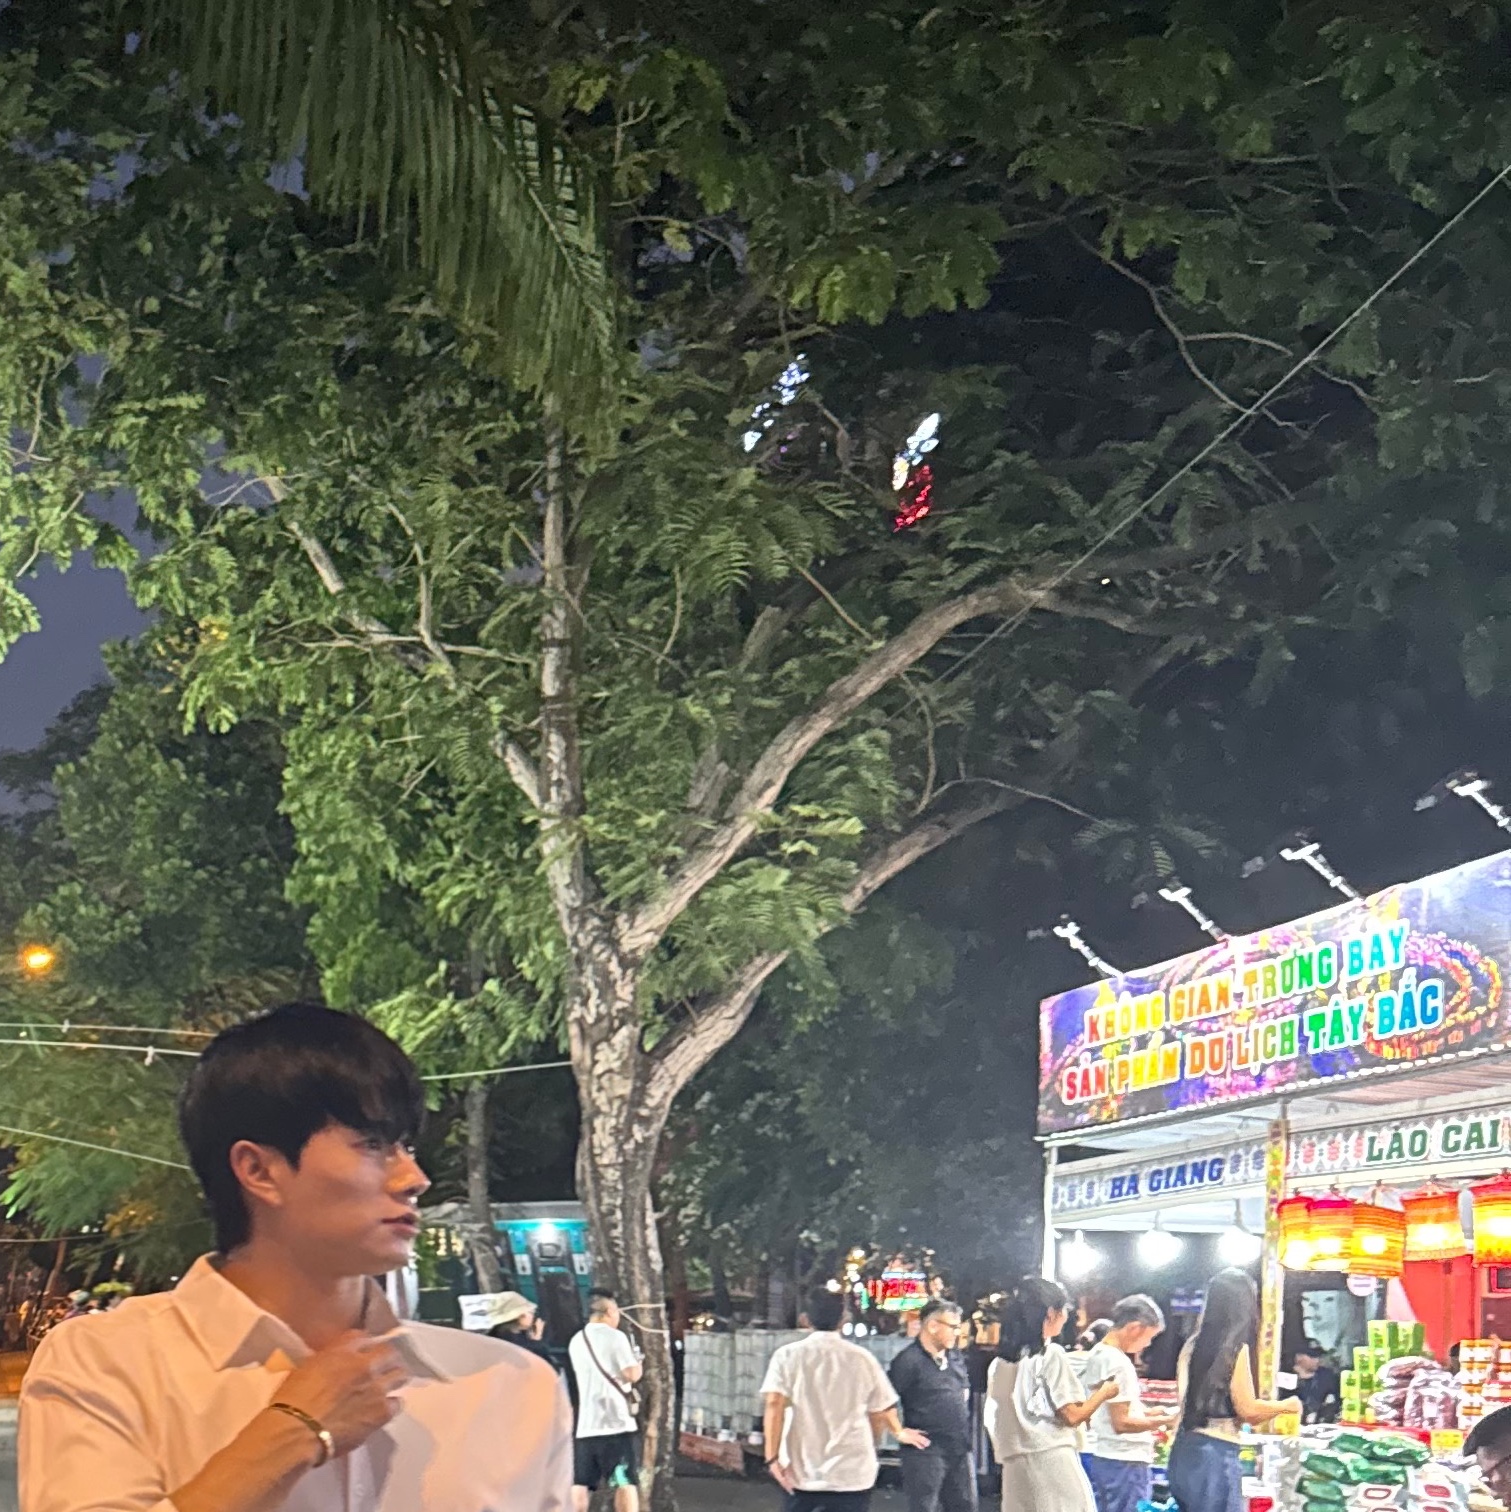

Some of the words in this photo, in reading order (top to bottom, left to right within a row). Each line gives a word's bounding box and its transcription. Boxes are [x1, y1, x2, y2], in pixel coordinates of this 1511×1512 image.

[1172, 978, 1231, 1022] GIAN
[1187, 1034, 1225, 1075] DU
[1441, 1118, 1501, 1153] CAI
[1148, 1157, 1226, 1192] GIANG
